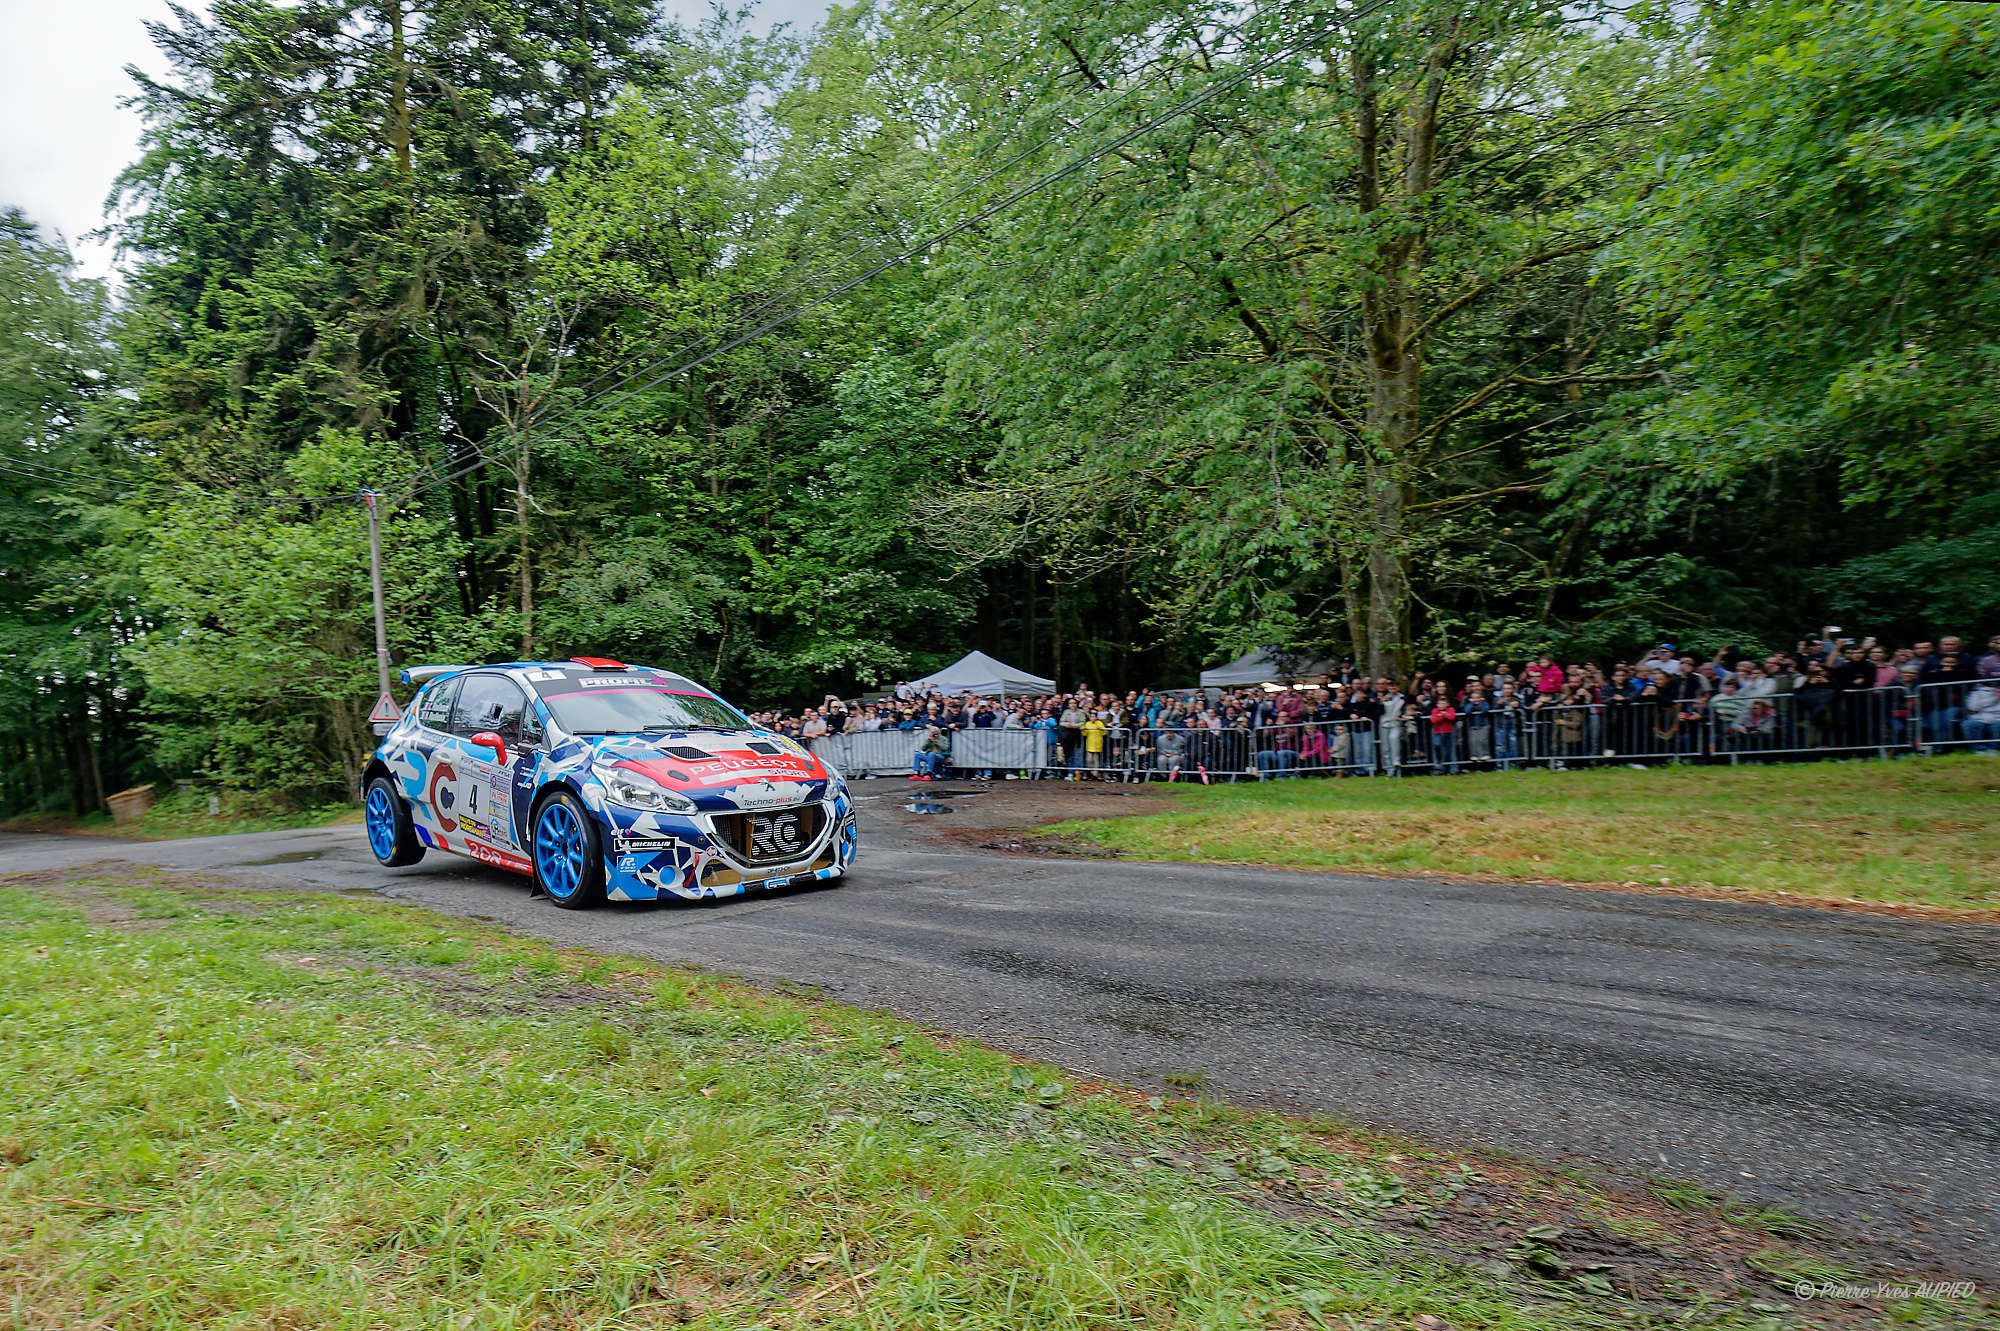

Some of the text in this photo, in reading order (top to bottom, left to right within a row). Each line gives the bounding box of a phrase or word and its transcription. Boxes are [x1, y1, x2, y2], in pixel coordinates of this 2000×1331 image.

[689, 758, 798, 775] PEUGEOT
[767, 768, 810, 778] SPORT
[468, 784, 479, 814] 4
[631, 840, 671, 848] MICHELIN
[469, 843, 502, 865] 208
